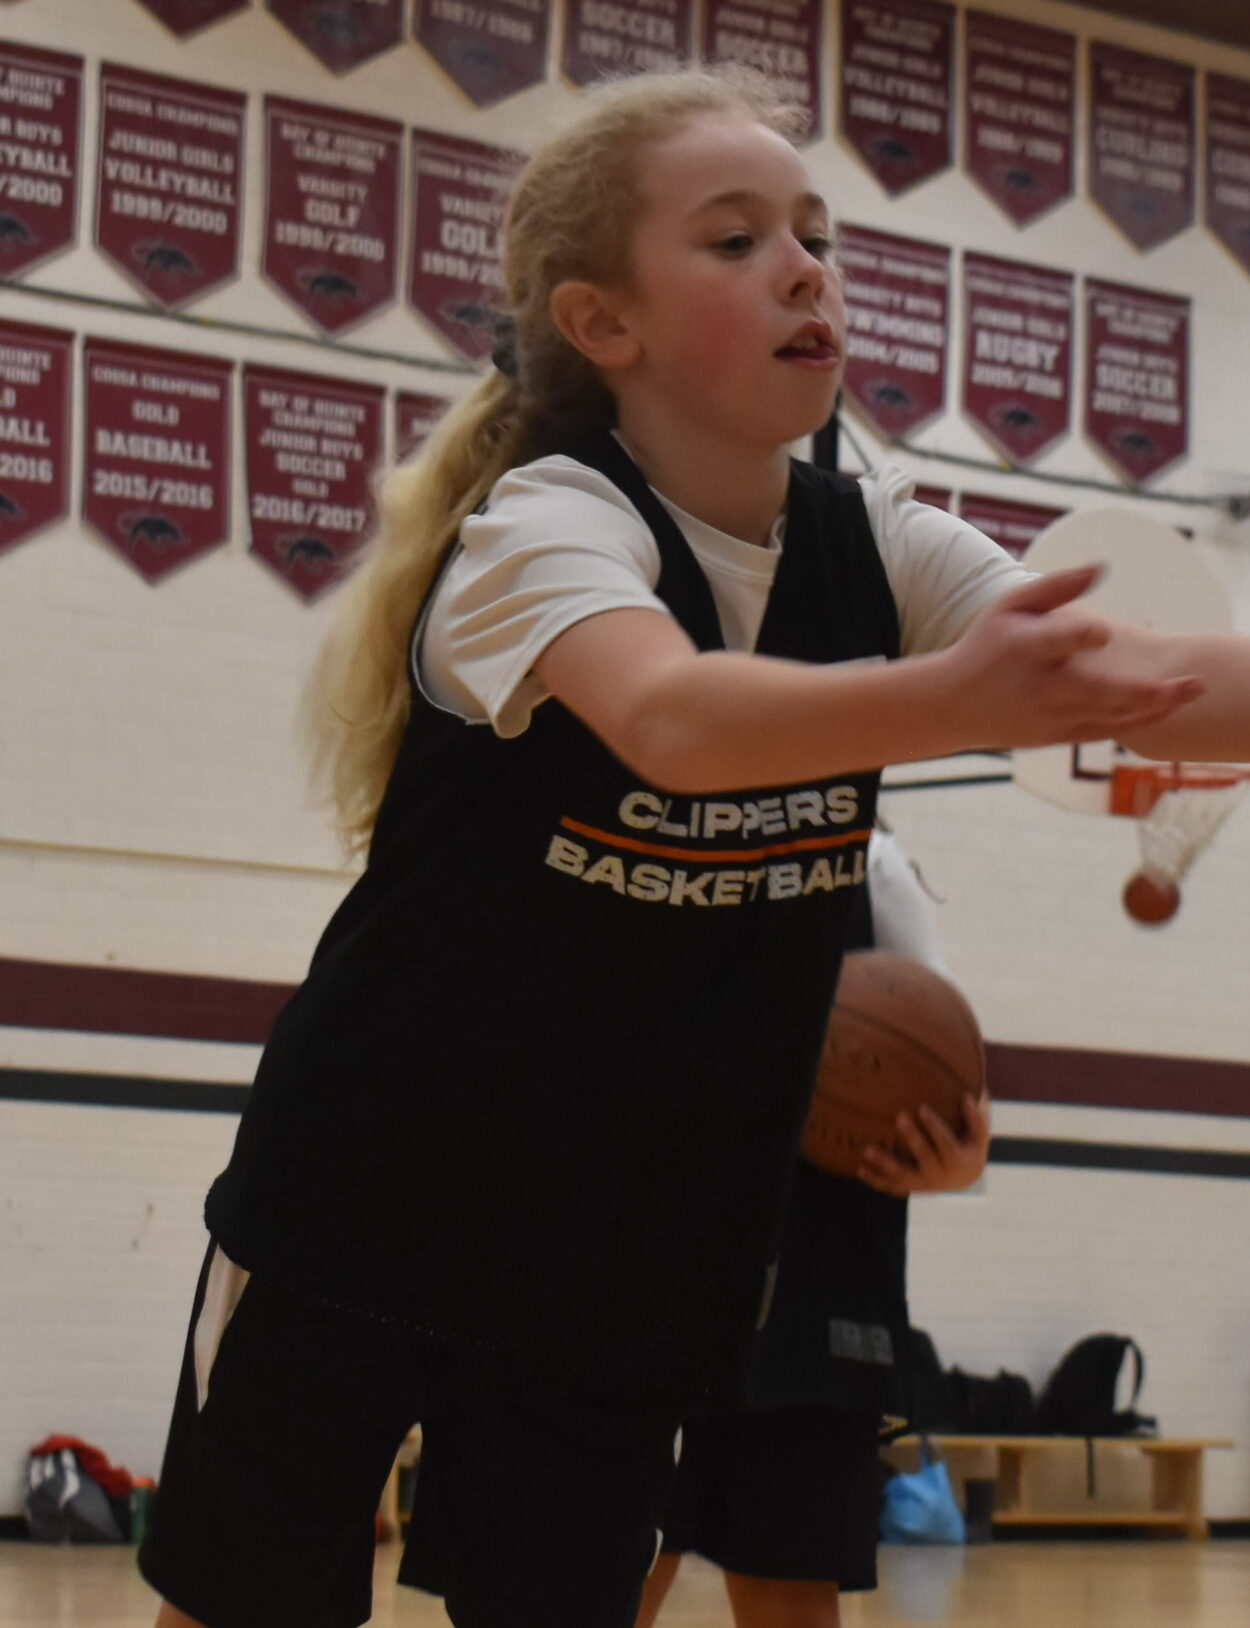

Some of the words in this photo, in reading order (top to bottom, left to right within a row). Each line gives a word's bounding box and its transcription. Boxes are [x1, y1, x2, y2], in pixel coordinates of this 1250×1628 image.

[15, 119, 63, 146] BOYS
[156, 103, 239, 136] CHAMPIONS
[109, 130, 178, 160] JUNIOR
[181, 145, 235, 175] GIRLS
[104, 156, 236, 204] VOLLEYBALL
[297, 172, 368, 204] VARSITY
[110, 189, 229, 235] 1999/2000
[304, 198, 361, 229] GOLF
[275, 220, 386, 262] 1999/2000
[976, 329, 1060, 372] RUGBY
[142, 374, 220, 401] CHAMPIONS
[1096, 363, 1175, 401] SOCCER
[132, 400, 180, 427] GOLD
[273, 410, 356, 438] CHAMPIONS
[96, 427, 212, 470] BASEBALL
[260, 428, 317, 452] JUNIOR
[321, 438, 364, 462] BOYS
[275, 451, 346, 481] SOCCER
[94, 468, 214, 510] 2015/2016
[253, 493, 366, 533] 2016/2017
[618, 785, 859, 839] CLIPPERS
[544, 834, 867, 907] BASKETBALL
